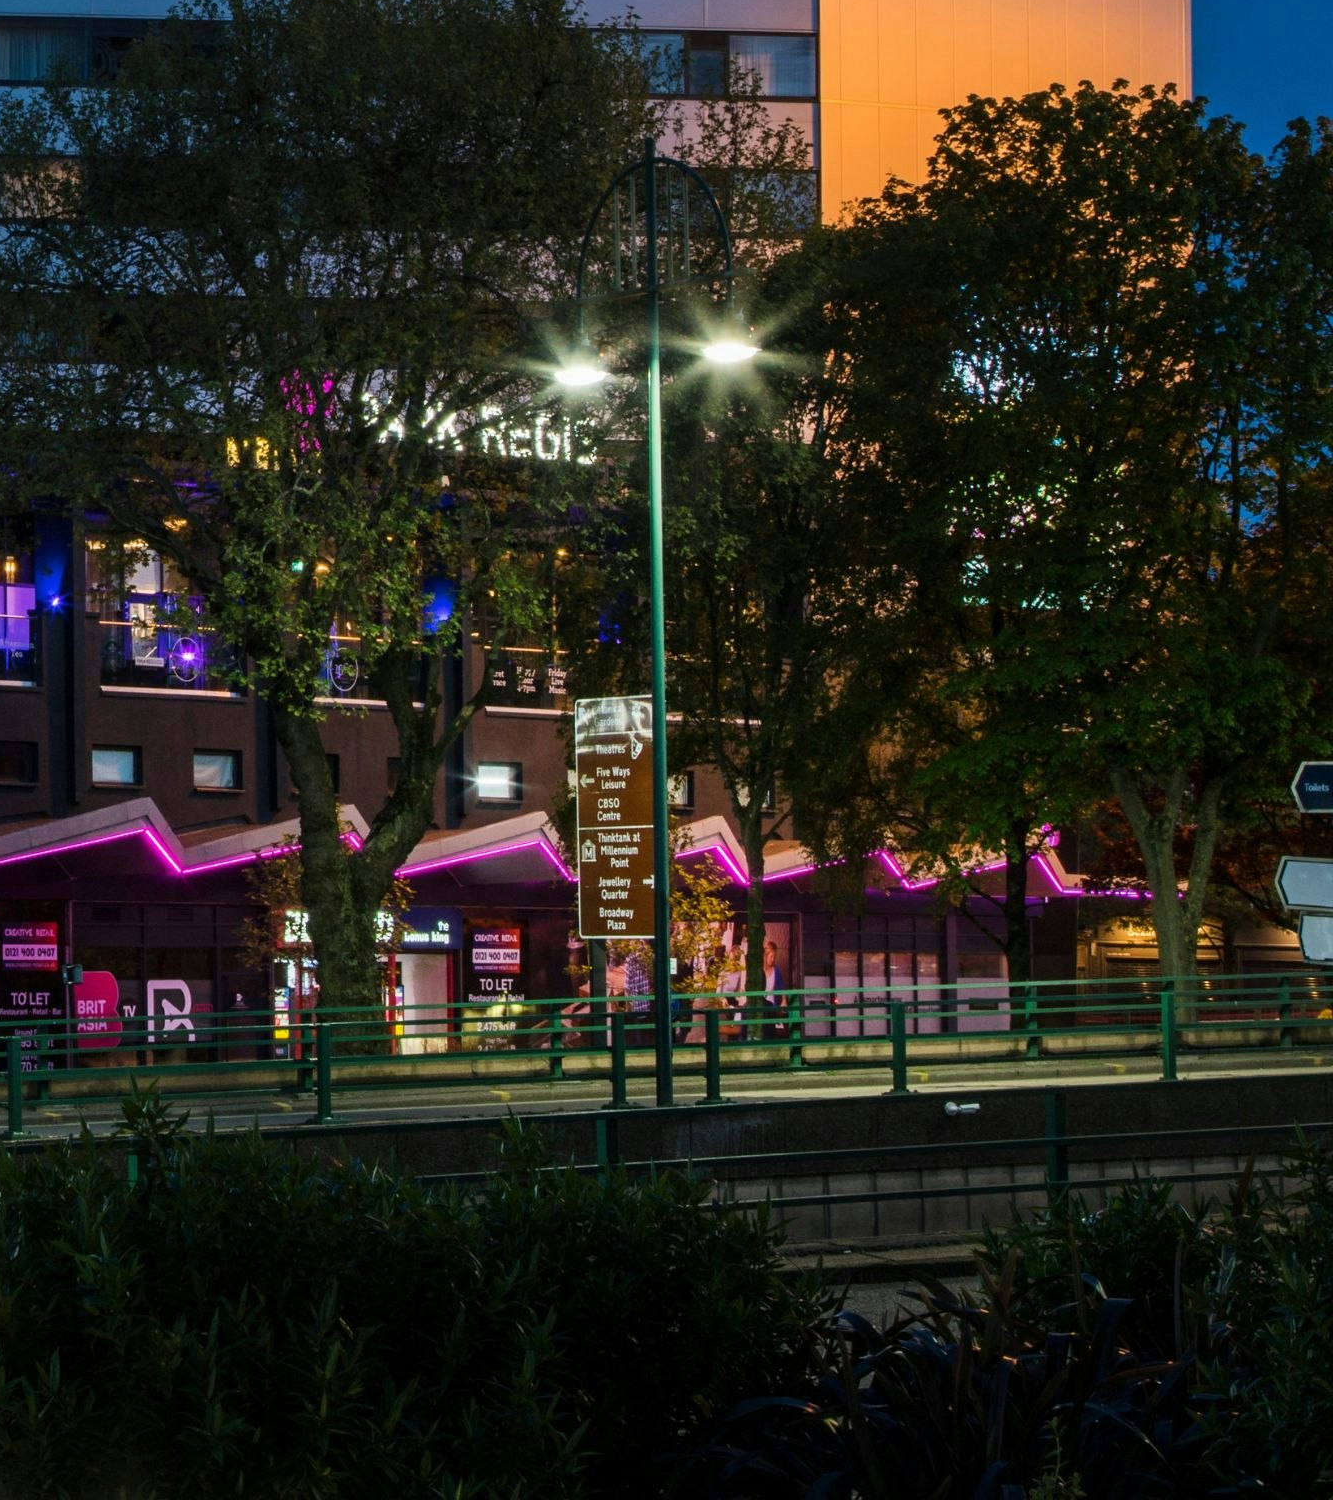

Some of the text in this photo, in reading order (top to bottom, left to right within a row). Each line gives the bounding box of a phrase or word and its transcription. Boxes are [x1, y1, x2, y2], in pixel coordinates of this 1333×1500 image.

[548, 668, 567, 678] Friday
[551, 678, 564, 686] Live
[548, 686, 566, 694] Music
[596, 744, 626, 754] Theatres
[596, 766, 630, 778] Five Ways
[602, 779, 626, 790] Leisure
[1304, 783, 1331, 792] Toilets
[597, 798, 620, 809] CBSO
[597, 811, 621, 821] Centre
[598, 832, 641, 843] Thinktank at
[600, 845, 639, 855] Millennium
[611, 858, 629, 868] Point
[598, 876, 631, 889] Jewellery
[601, 890, 629, 900] Quarter
[599, 907, 634, 919] Broadway
[437, 921, 450, 931] the
[607, 919, 626, 930] Plaza
[5, 928, 56, 937] CREATIVE RETAIL
[404, 932, 450, 944] bonus king
[474, 934, 518, 942] CREATIVE RETAIL
[5, 948, 55, 957] 0121 400 0407
[475, 952, 518, 960] 0121 400 0407
[479, 979, 514, 991] TO LET
[11, 992, 50, 1006] TO LET
[468, 994, 499, 1003] Restaurant
[508, 993, 525, 1002] Retail
[0, 1008, 28, 1016] Restaurant
[77, 999, 107, 1015] BRIT
[123, 1005, 136, 1018] TV
[77, 1017, 108, 1031] ASIA
